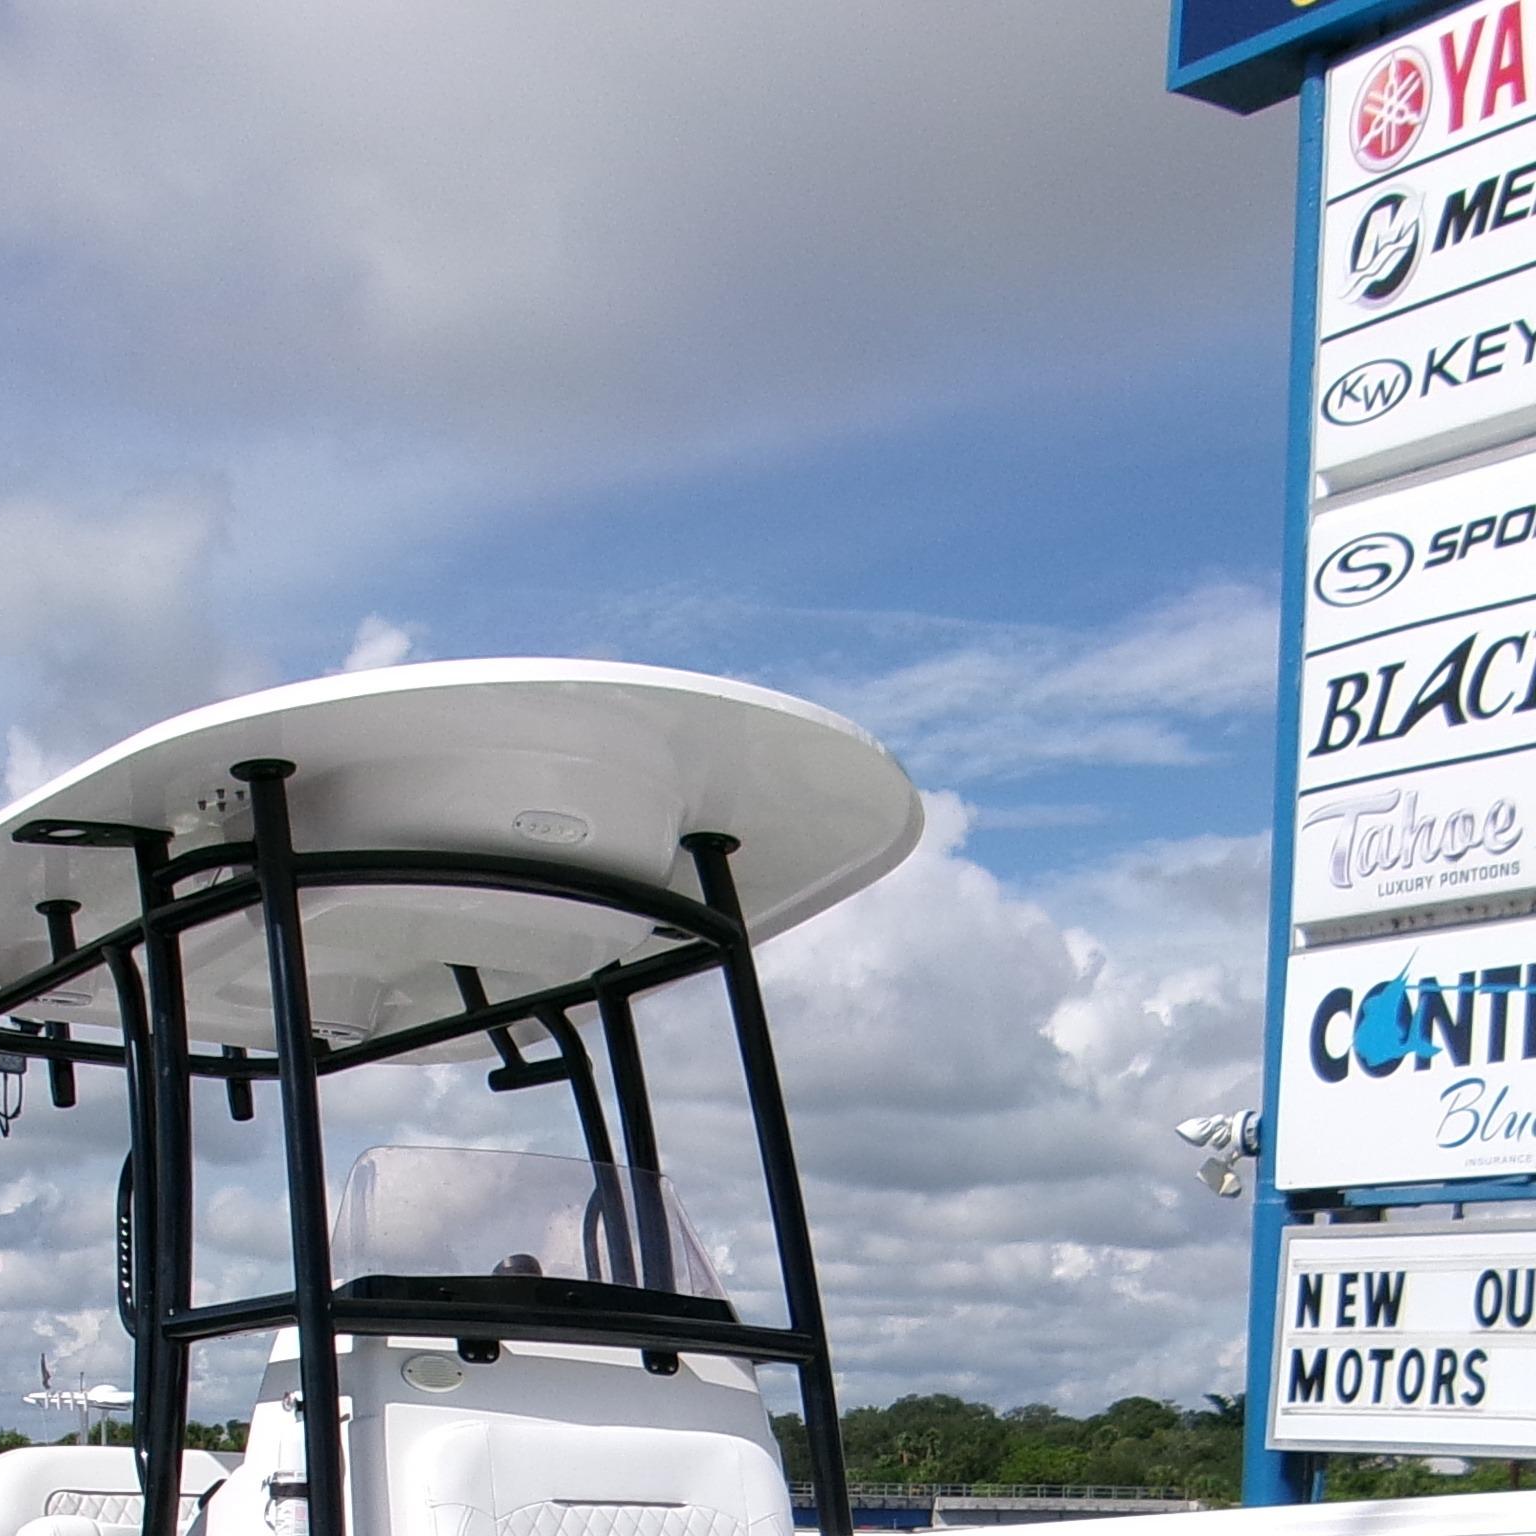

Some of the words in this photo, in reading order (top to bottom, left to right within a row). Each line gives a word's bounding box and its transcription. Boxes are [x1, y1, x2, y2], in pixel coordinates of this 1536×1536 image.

[1336, 368, 1404, 410] KW
[1301, 788, 1526, 890] Tahoe
[1377, 875, 1434, 898] LUXURY
[1439, 860, 1521, 889] PONTOONS
[1464, 1154, 1533, 1168] INSURANCE
[1294, 1271, 1406, 1329] NEW
[1288, 1348, 1488, 1407] MOTORS
